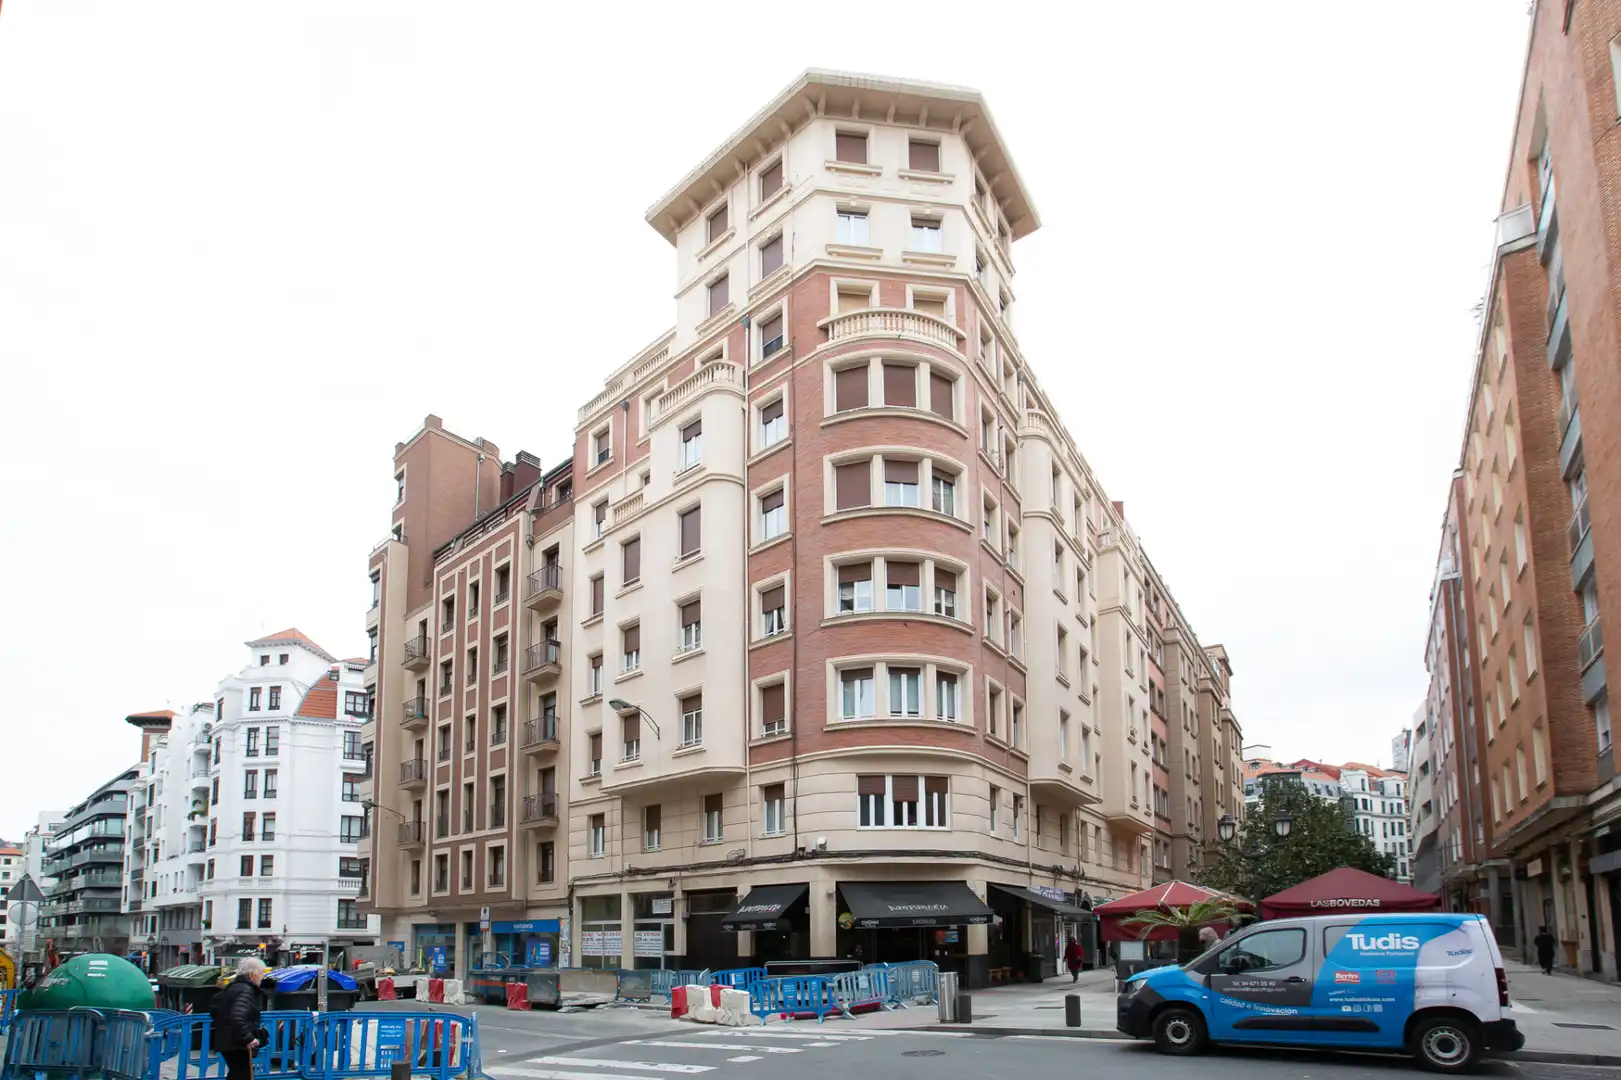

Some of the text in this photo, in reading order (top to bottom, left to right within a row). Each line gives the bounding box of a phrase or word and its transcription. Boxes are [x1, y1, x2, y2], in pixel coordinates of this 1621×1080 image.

[1345, 933, 1420, 950] Tudis
[1446, 949, 1473, 957] Tudis
[1219, 997, 1245, 1008] calidad
